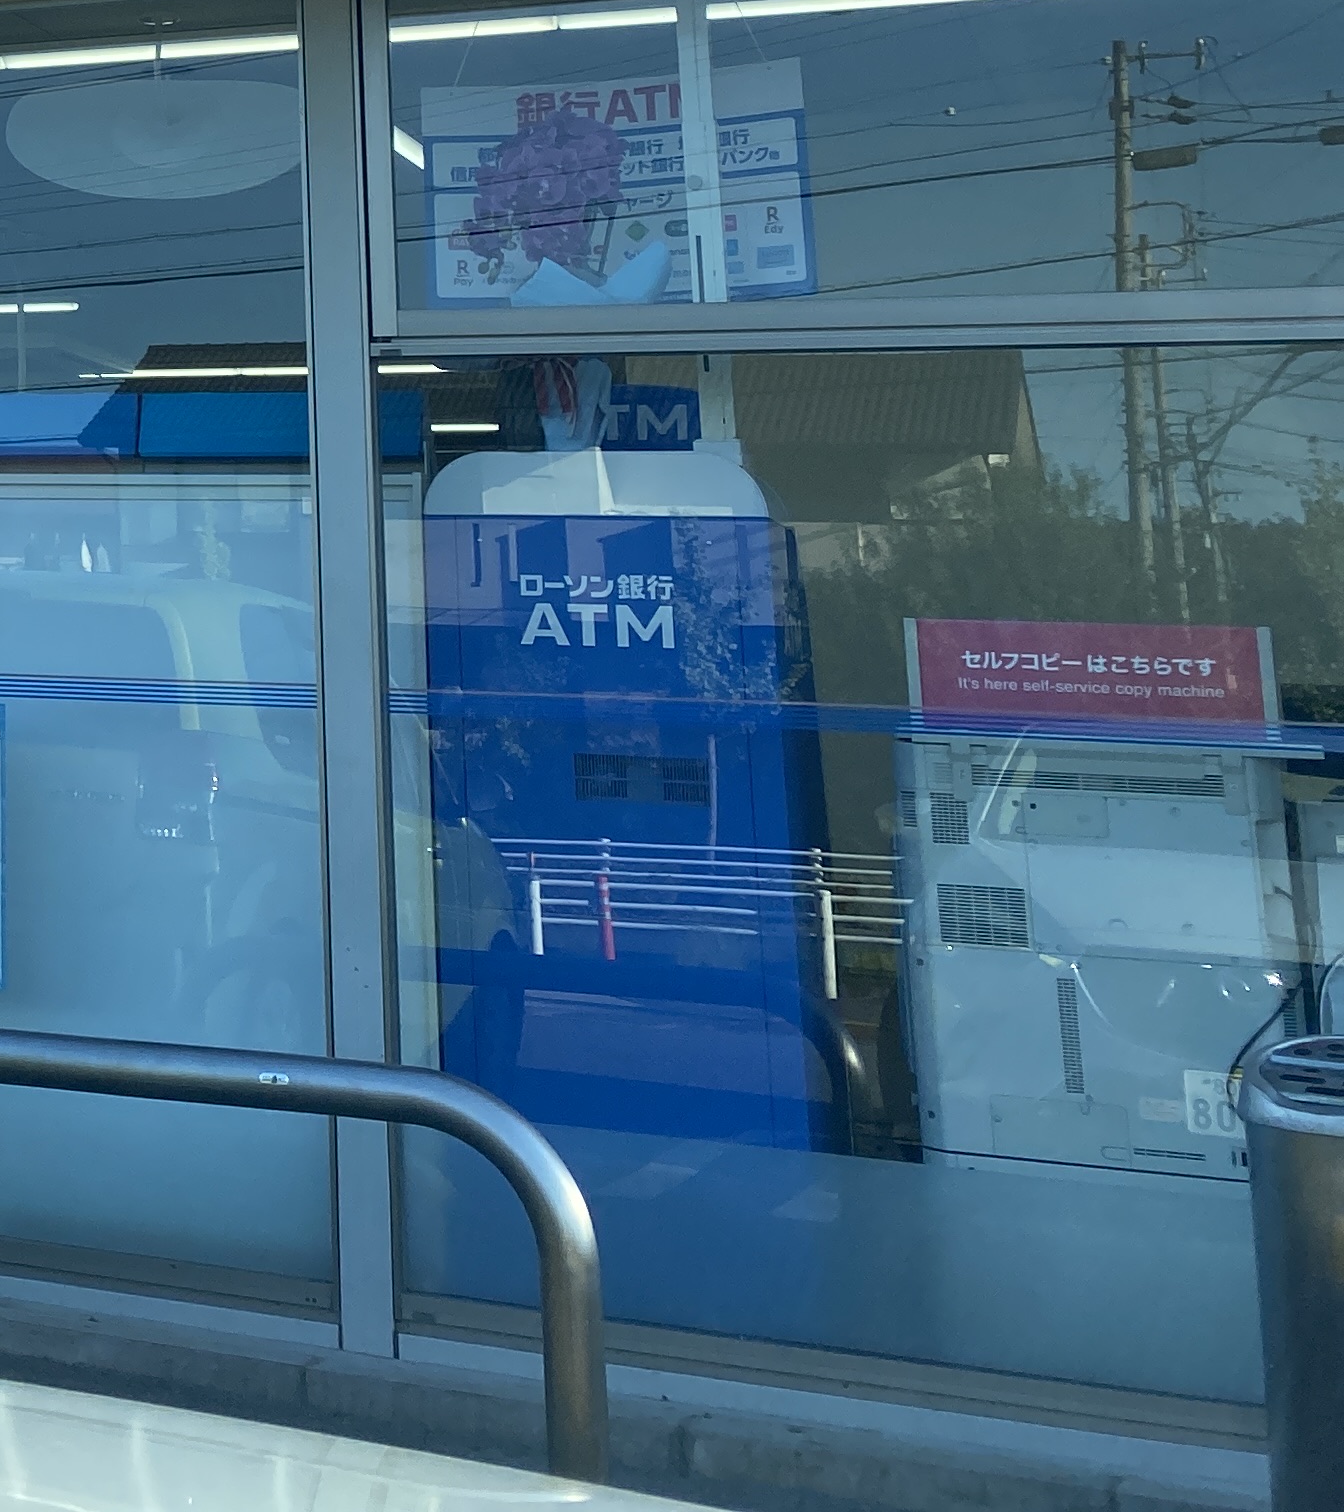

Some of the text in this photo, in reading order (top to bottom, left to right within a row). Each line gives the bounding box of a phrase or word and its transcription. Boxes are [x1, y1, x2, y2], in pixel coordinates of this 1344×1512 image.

[519, 575, 675, 602] ローソン銀行
[520, 604, 676, 650] ATM
[961, 649, 1216, 678] セルフコピーはこちらです
[985, 678, 1018, 693] here
[1023, 679, 1110, 696] self-service
[1115, 684, 1153, 699] copy
[1158, 683, 1225, 700] machine
